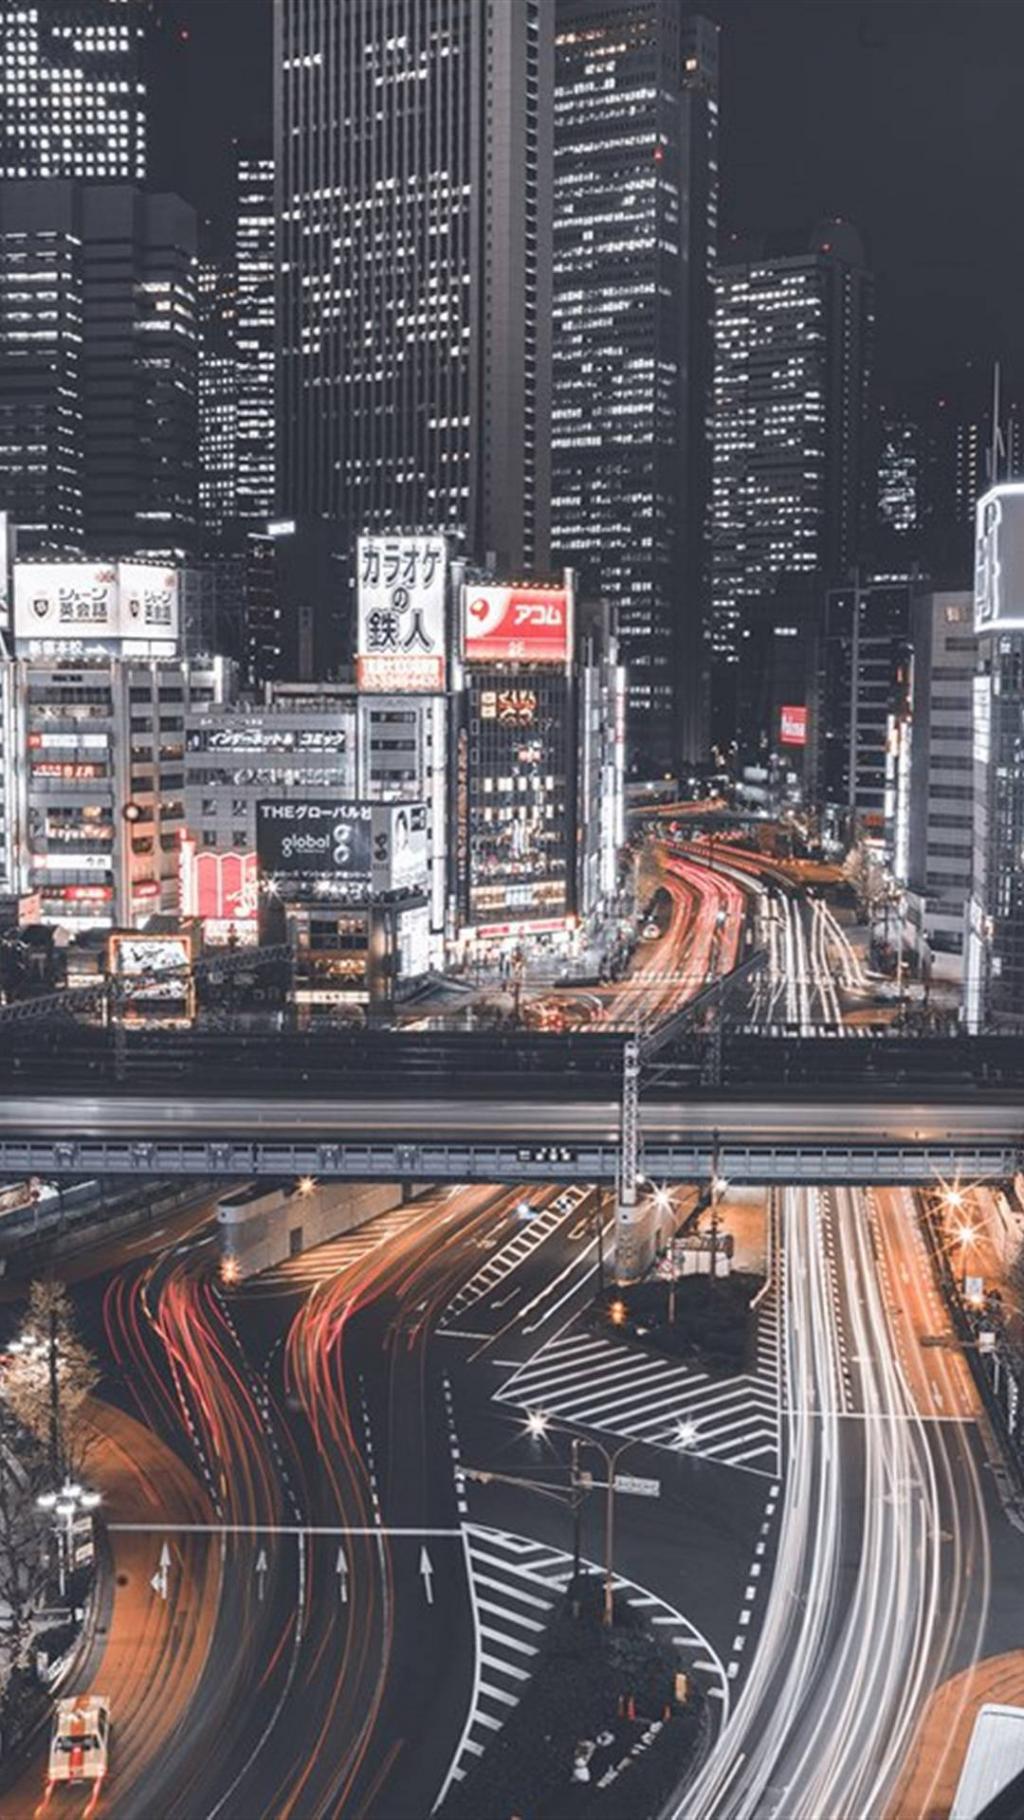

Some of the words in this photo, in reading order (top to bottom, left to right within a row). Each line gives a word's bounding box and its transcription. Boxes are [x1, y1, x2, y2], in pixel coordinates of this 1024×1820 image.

[363, 544, 441, 586] カラオケ
[60, 602, 108, 617] 英会話
[393, 587, 410, 611] の
[514, 604, 562, 625] アコム
[367, 609, 433, 651] 鉄人
[282, 834, 330, 858] global
